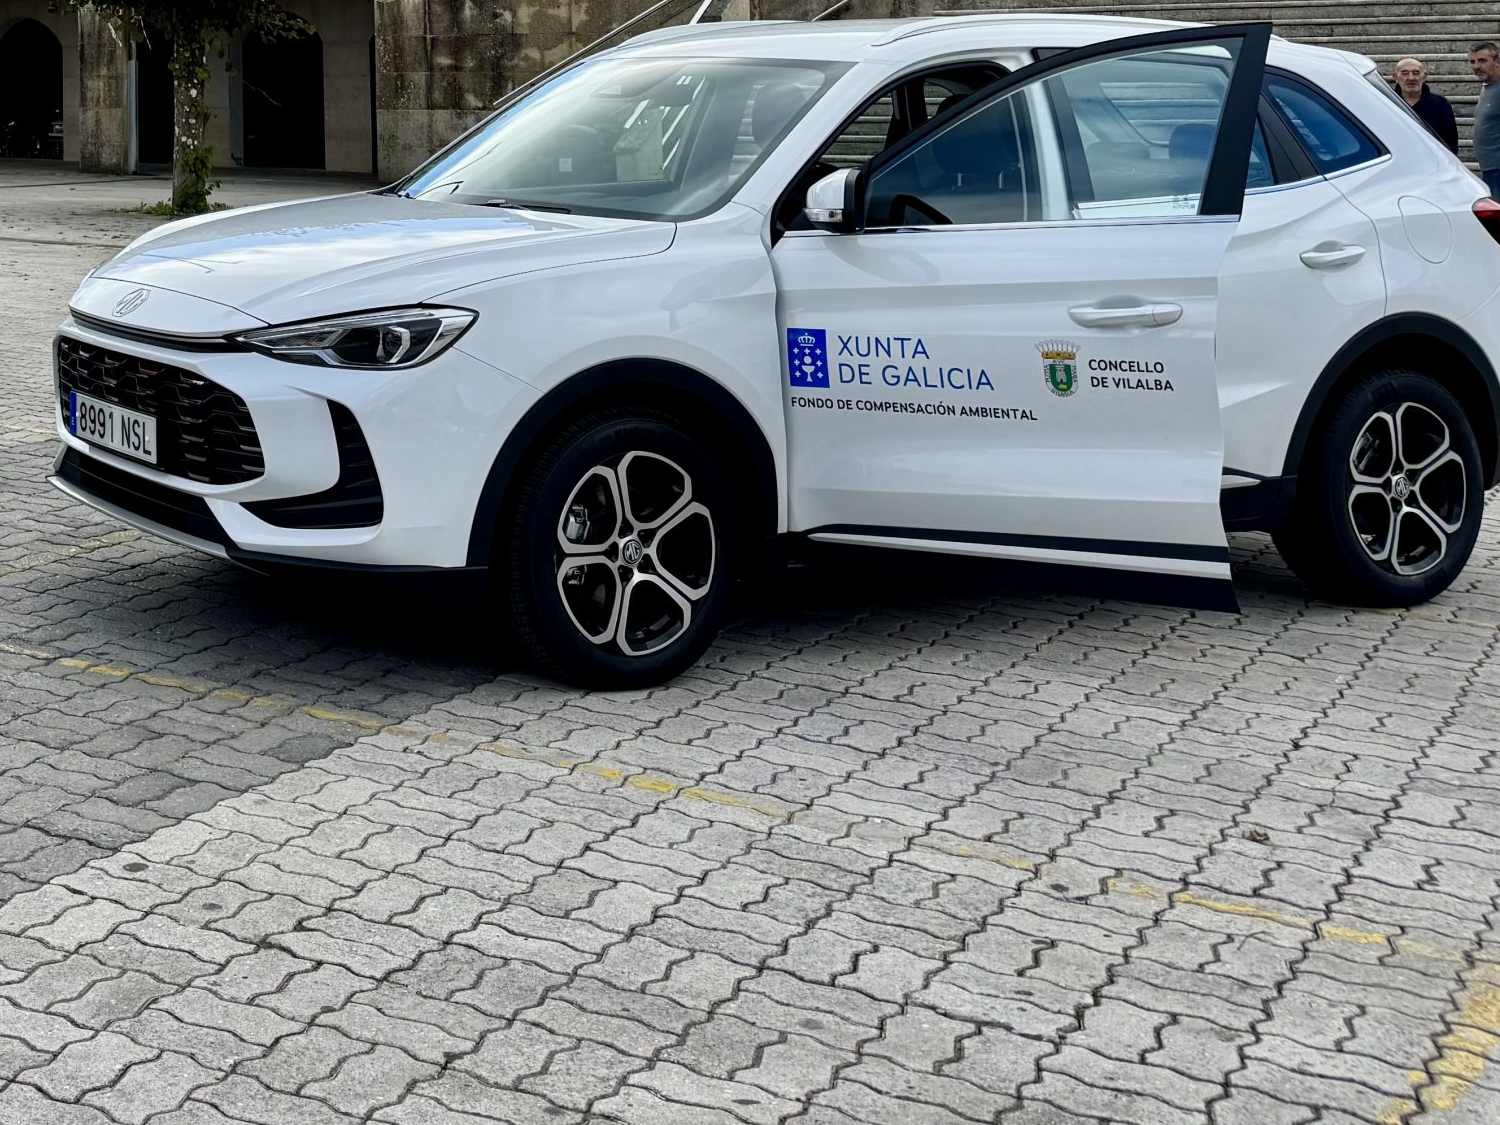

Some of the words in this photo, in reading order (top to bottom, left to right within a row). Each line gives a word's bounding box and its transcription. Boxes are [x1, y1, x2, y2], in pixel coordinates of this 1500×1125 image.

[837, 335, 930, 360] XUNTA
[838, 362, 873, 385] DE
[881, 364, 995, 391] GALICIA
[1088, 358, 1165, 374] CONCELLO
[1090, 376, 1109, 389] DE
[1112, 376, 1175, 392] VILALBA
[790, 396, 834, 410] FONDO
[837, 399, 853, 411] DE
[855, 398, 957, 416] COMPENSACIÓN
[959, 405, 1038, 421] AMBIENTAL
[79, 401, 115, 444] 8991
[121, 414, 152, 456] NSL
